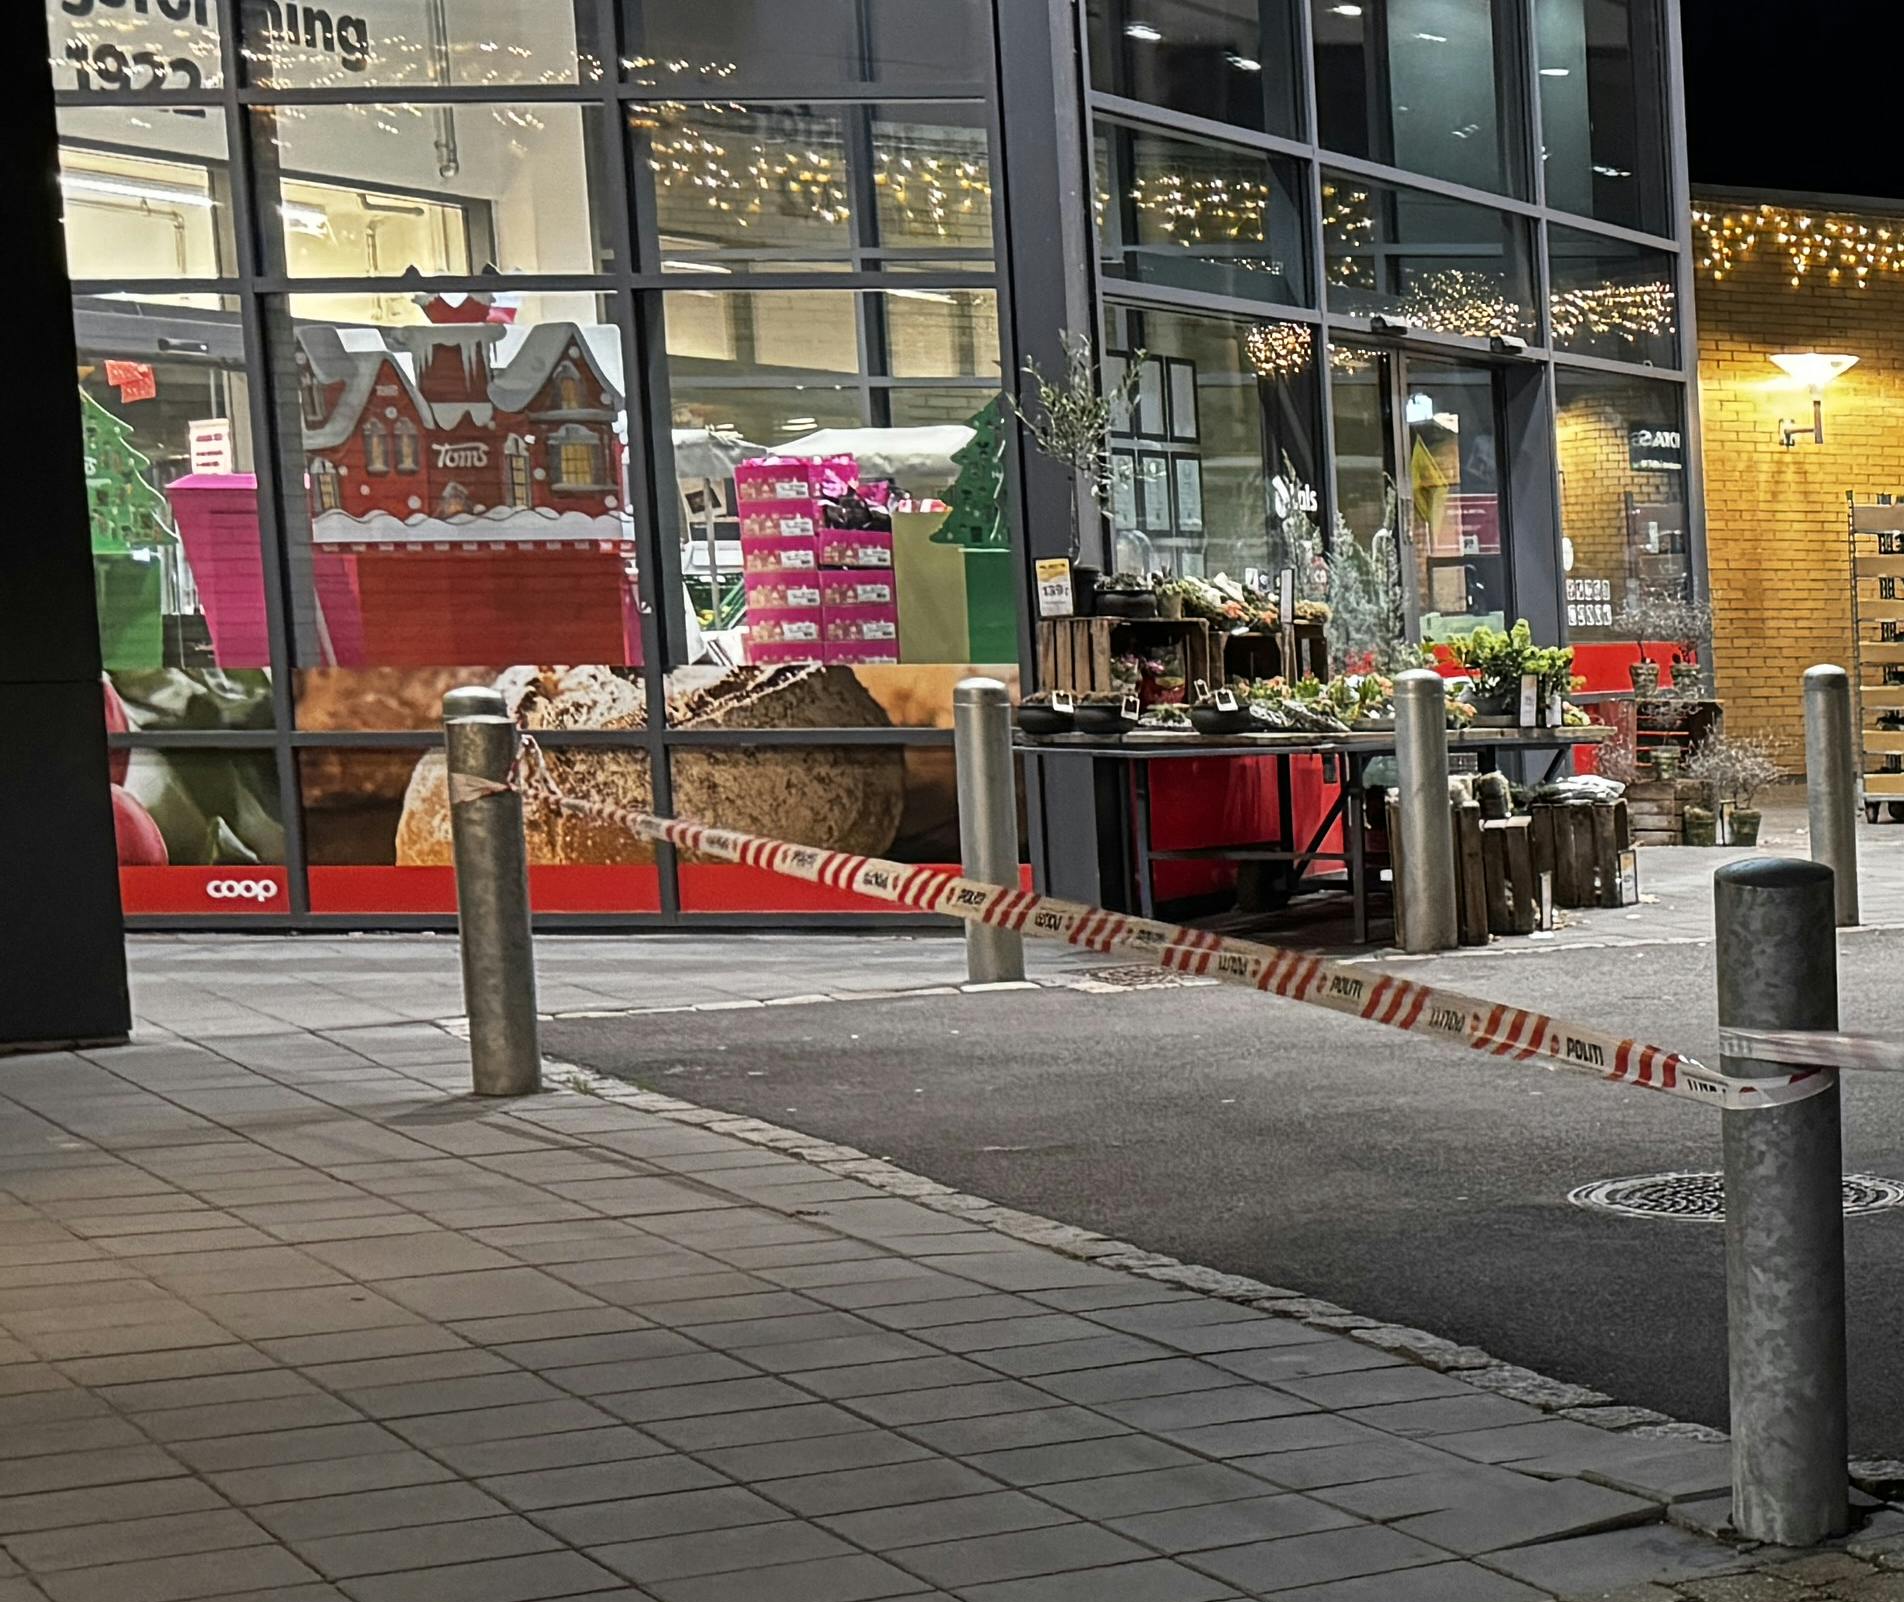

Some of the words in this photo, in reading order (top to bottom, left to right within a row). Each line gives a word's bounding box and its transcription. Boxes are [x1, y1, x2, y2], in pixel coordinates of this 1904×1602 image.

[431, 442, 490, 468] Toms
[206, 879, 279, 902] coop
[1566, 1036, 1605, 1067] POLITI
